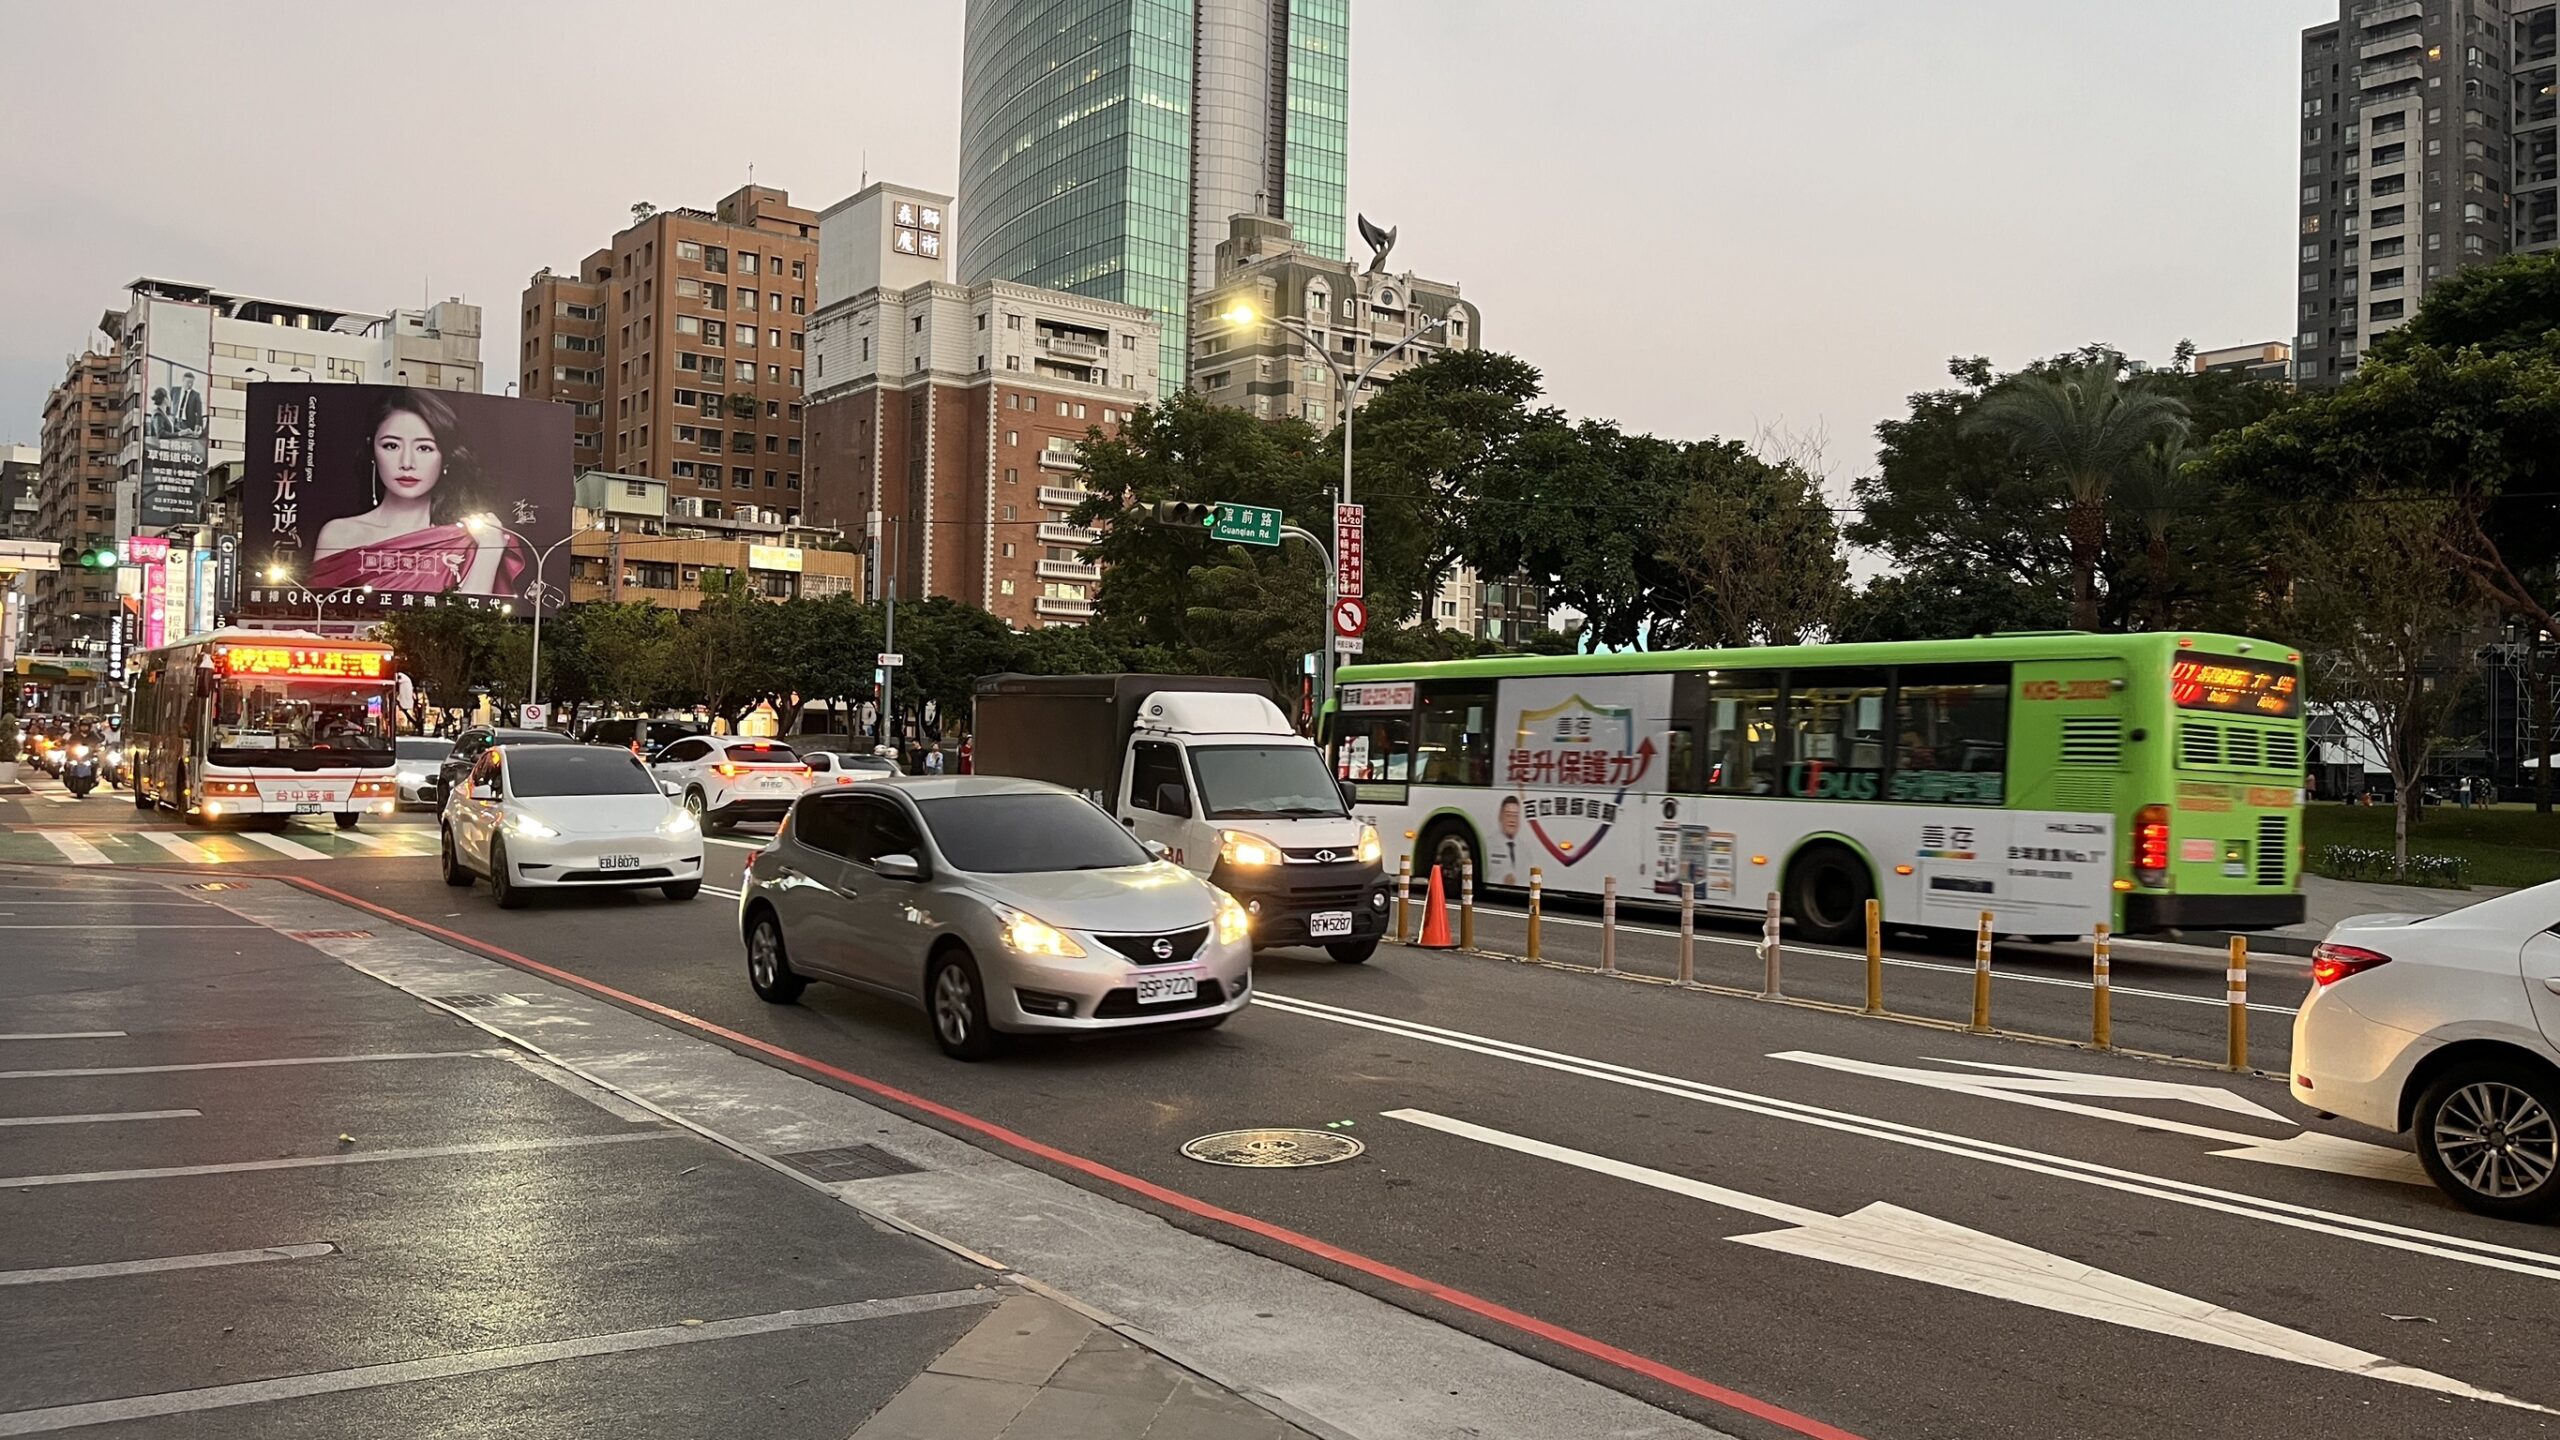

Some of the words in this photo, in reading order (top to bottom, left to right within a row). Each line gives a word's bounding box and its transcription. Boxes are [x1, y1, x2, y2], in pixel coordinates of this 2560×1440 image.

[308, 396, 317, 409] Get
[308, 411, 317, 428] back
[307, 438, 316, 451] the
[306, 453, 315, 467] real
[305, 468, 314, 482] you
[1221, 525, 1255, 537] Guanqian
[1259, 529, 1270, 539] Rd.
[1350, 529, 1360, 595] 館前路封閉
[287, 591, 366, 606] QRcode
[1507, 749, 1634, 785] 提升保護力
[276, 789, 336, 802] 台中客運
[1312, 917, 1351, 932] RFM-5287
